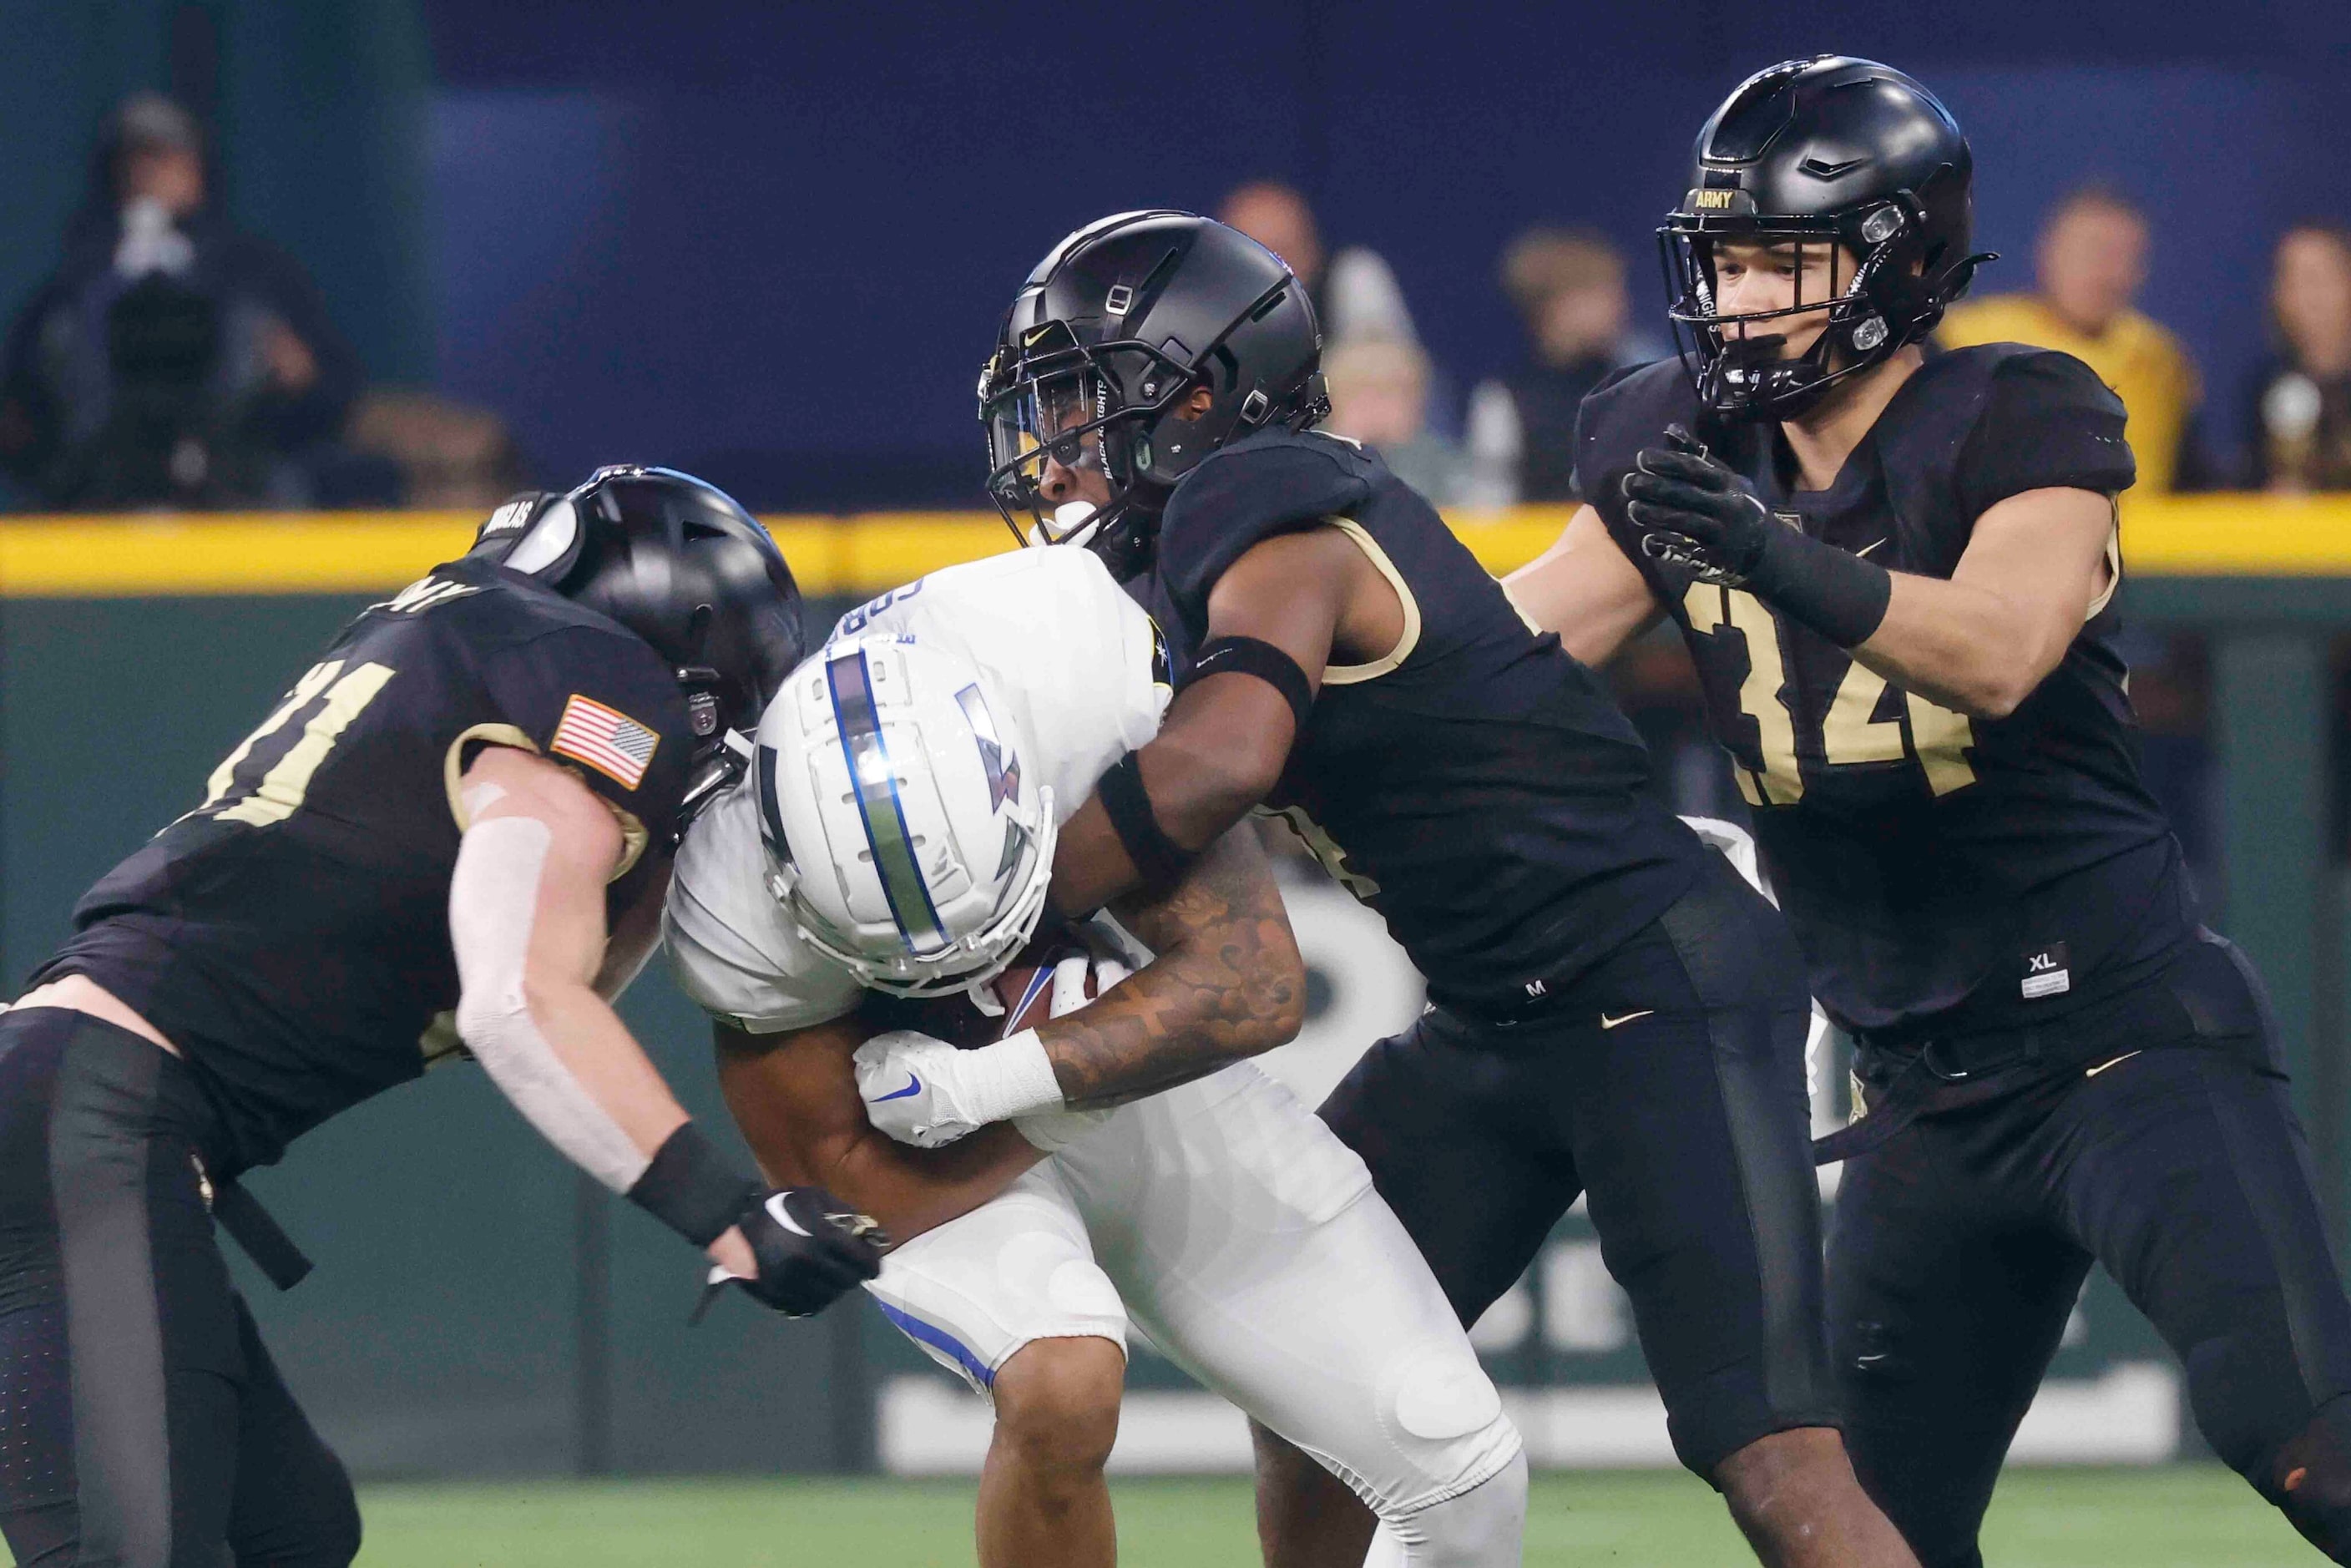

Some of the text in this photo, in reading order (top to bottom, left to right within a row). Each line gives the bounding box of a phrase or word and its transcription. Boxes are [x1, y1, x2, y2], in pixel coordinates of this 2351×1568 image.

[1696, 191, 1733, 208] ARMY
[1096, 379, 1114, 480] BLACK KIGHTS
[1683, 580, 1977, 807] 34
[2029, 953, 2057, 973] XL
[1525, 979, 1546, 997] M
